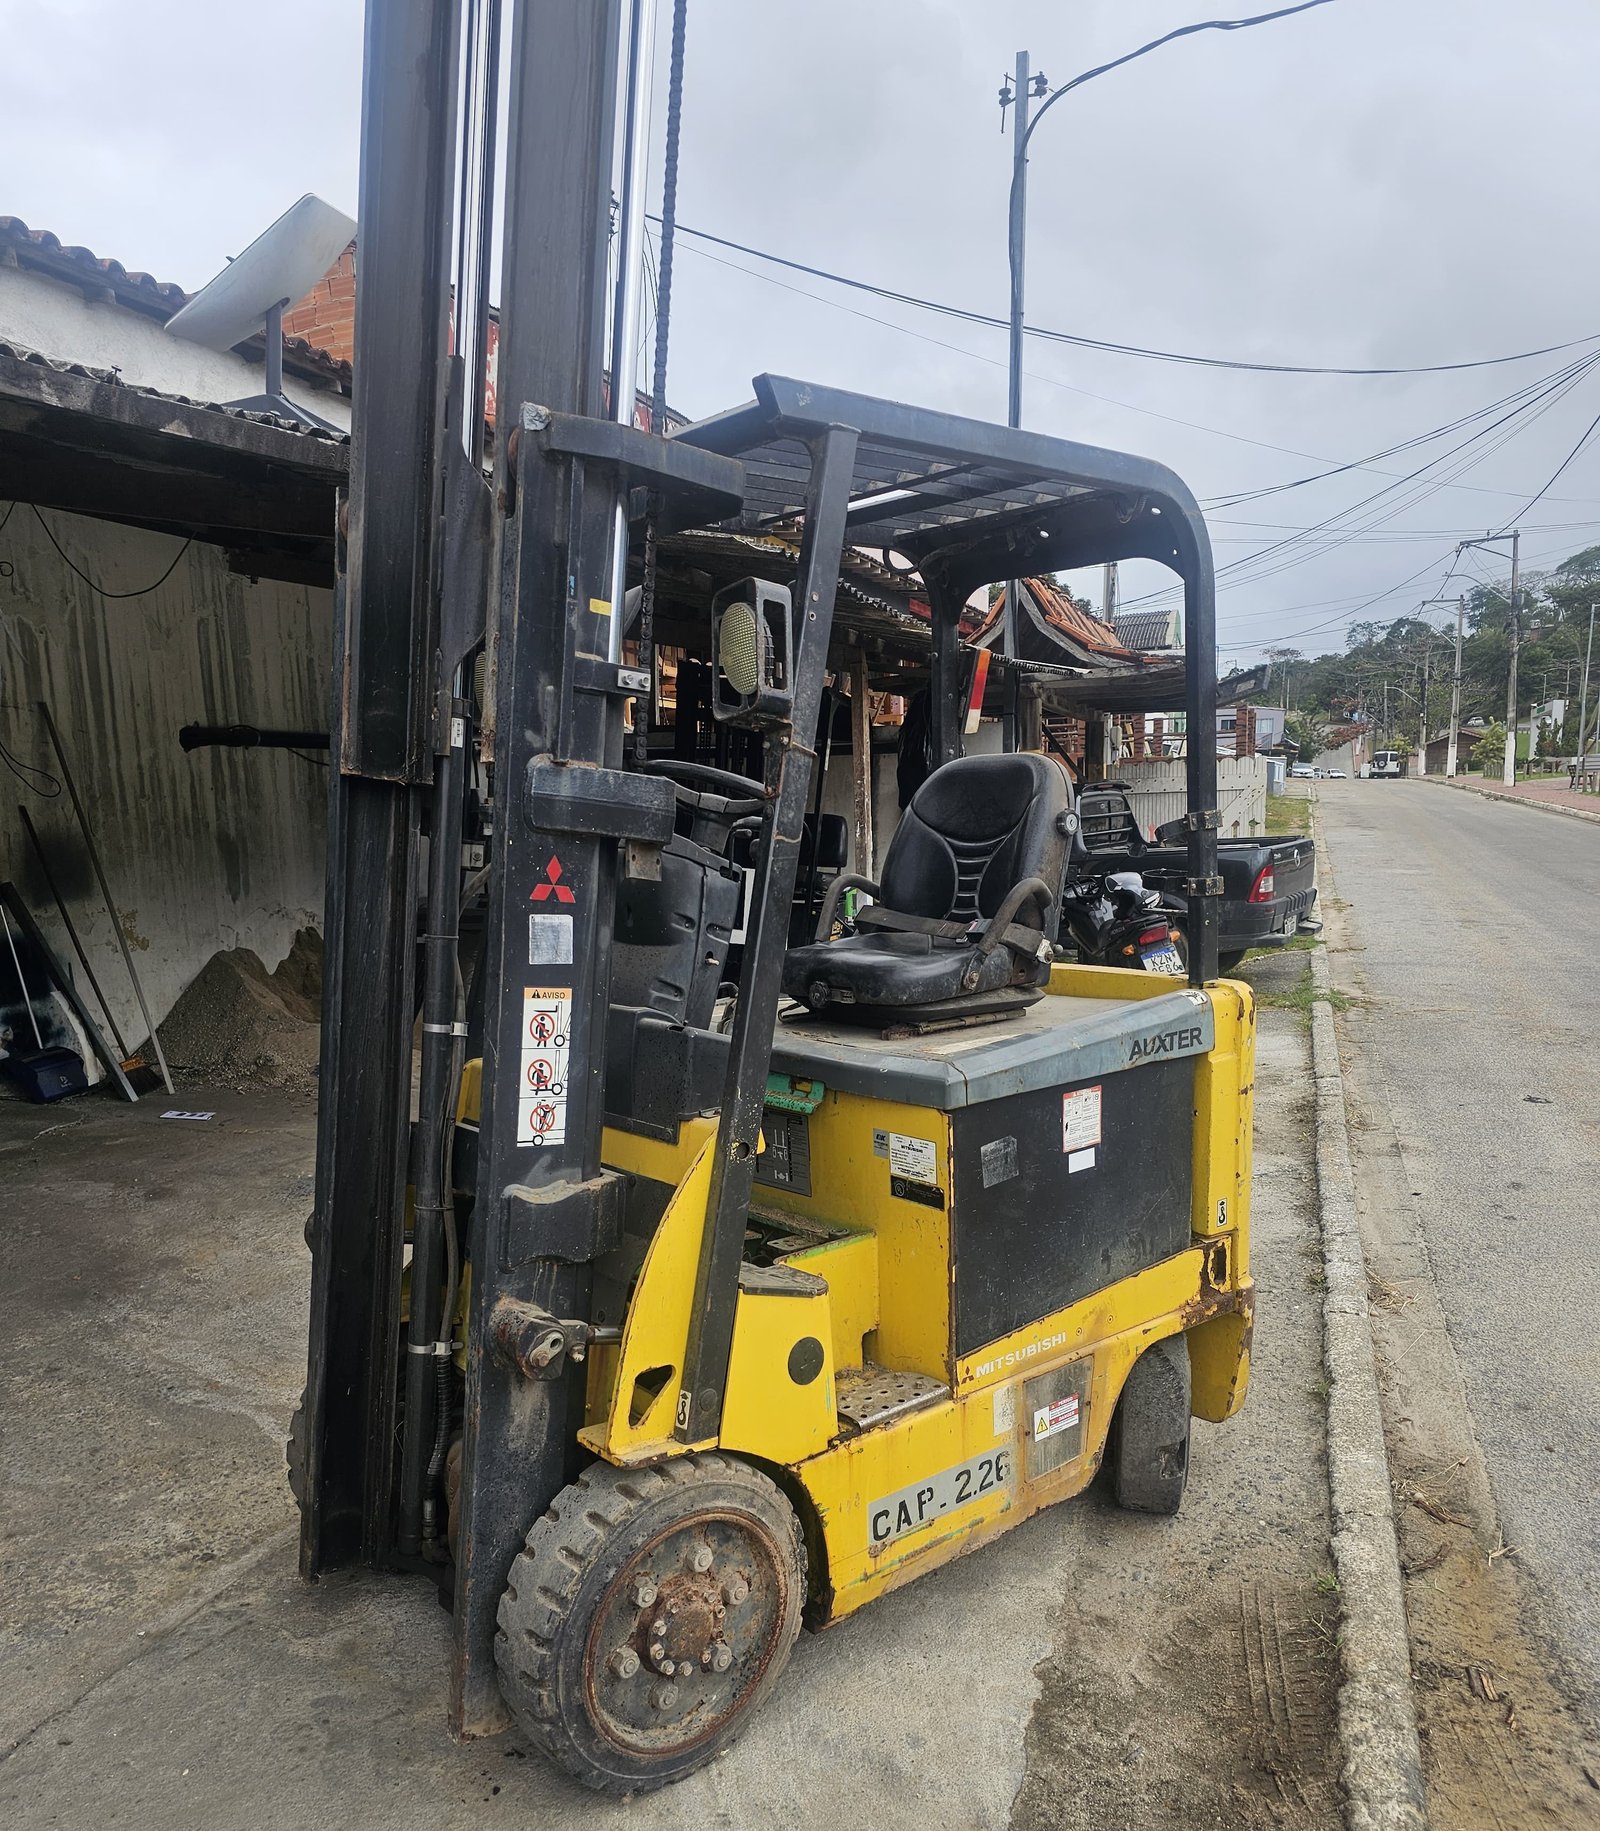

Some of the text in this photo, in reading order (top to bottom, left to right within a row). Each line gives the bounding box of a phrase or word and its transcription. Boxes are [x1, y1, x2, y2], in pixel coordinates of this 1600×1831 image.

[1150, 953, 1173, 968] KZN
[542, 991, 566, 999] AVISO
[1129, 1027, 1203, 1061] AUXTER
[975, 1332, 1066, 1378] MITSUBISHI
